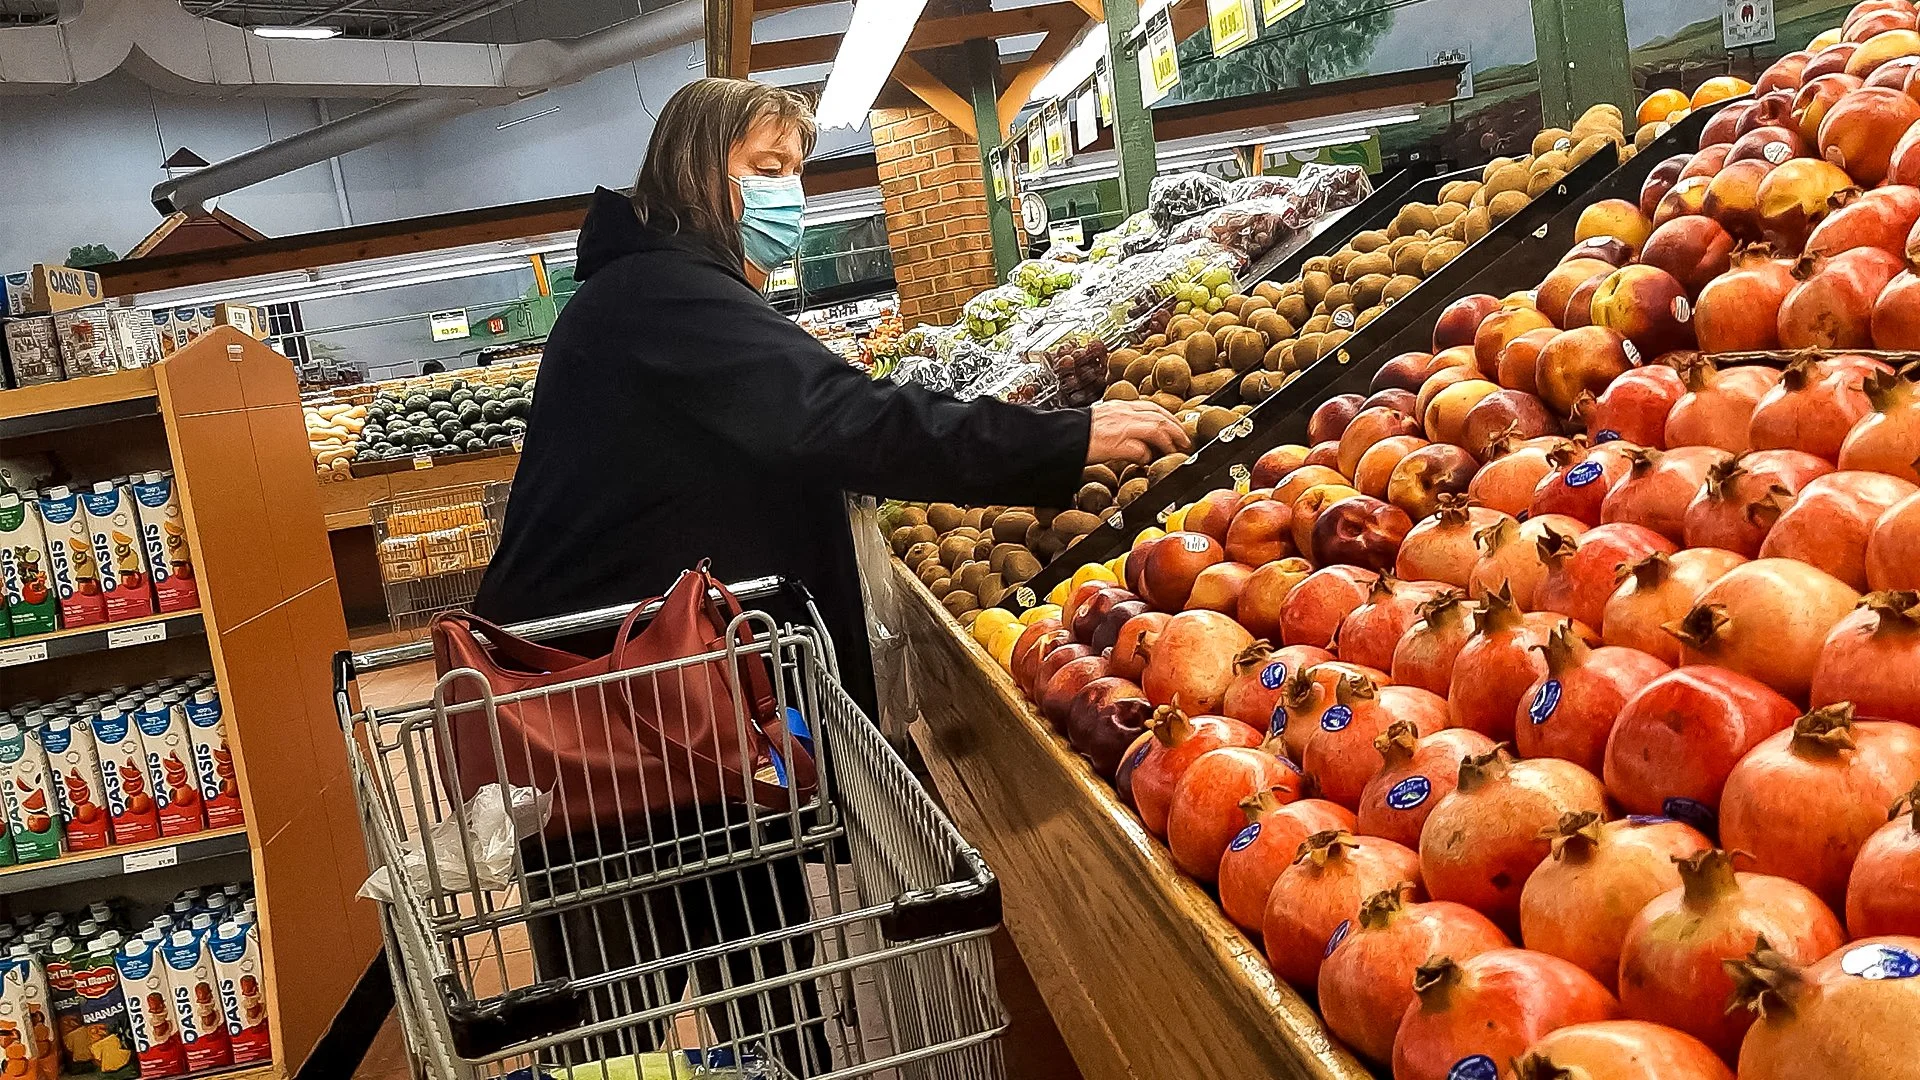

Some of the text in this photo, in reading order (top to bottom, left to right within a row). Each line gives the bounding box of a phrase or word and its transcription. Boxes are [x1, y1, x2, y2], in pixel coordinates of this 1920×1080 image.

[49, 270, 82, 297] OASIS
[2, 548, 21, 606] OASIS
[52, 540, 73, 600] OASIS
[93, 532, 117, 593] OASIS
[144, 523, 169, 583] OASIS
[101, 760, 125, 819] OASIS
[147, 752, 169, 810] OASIS
[196, 743, 219, 801] OASIS
[4, 780, 23, 835] OASIS
[128, 997, 150, 1053] OASIS
[175, 986, 198, 1044] OASIS
[221, 979, 243, 1037] OASIS
